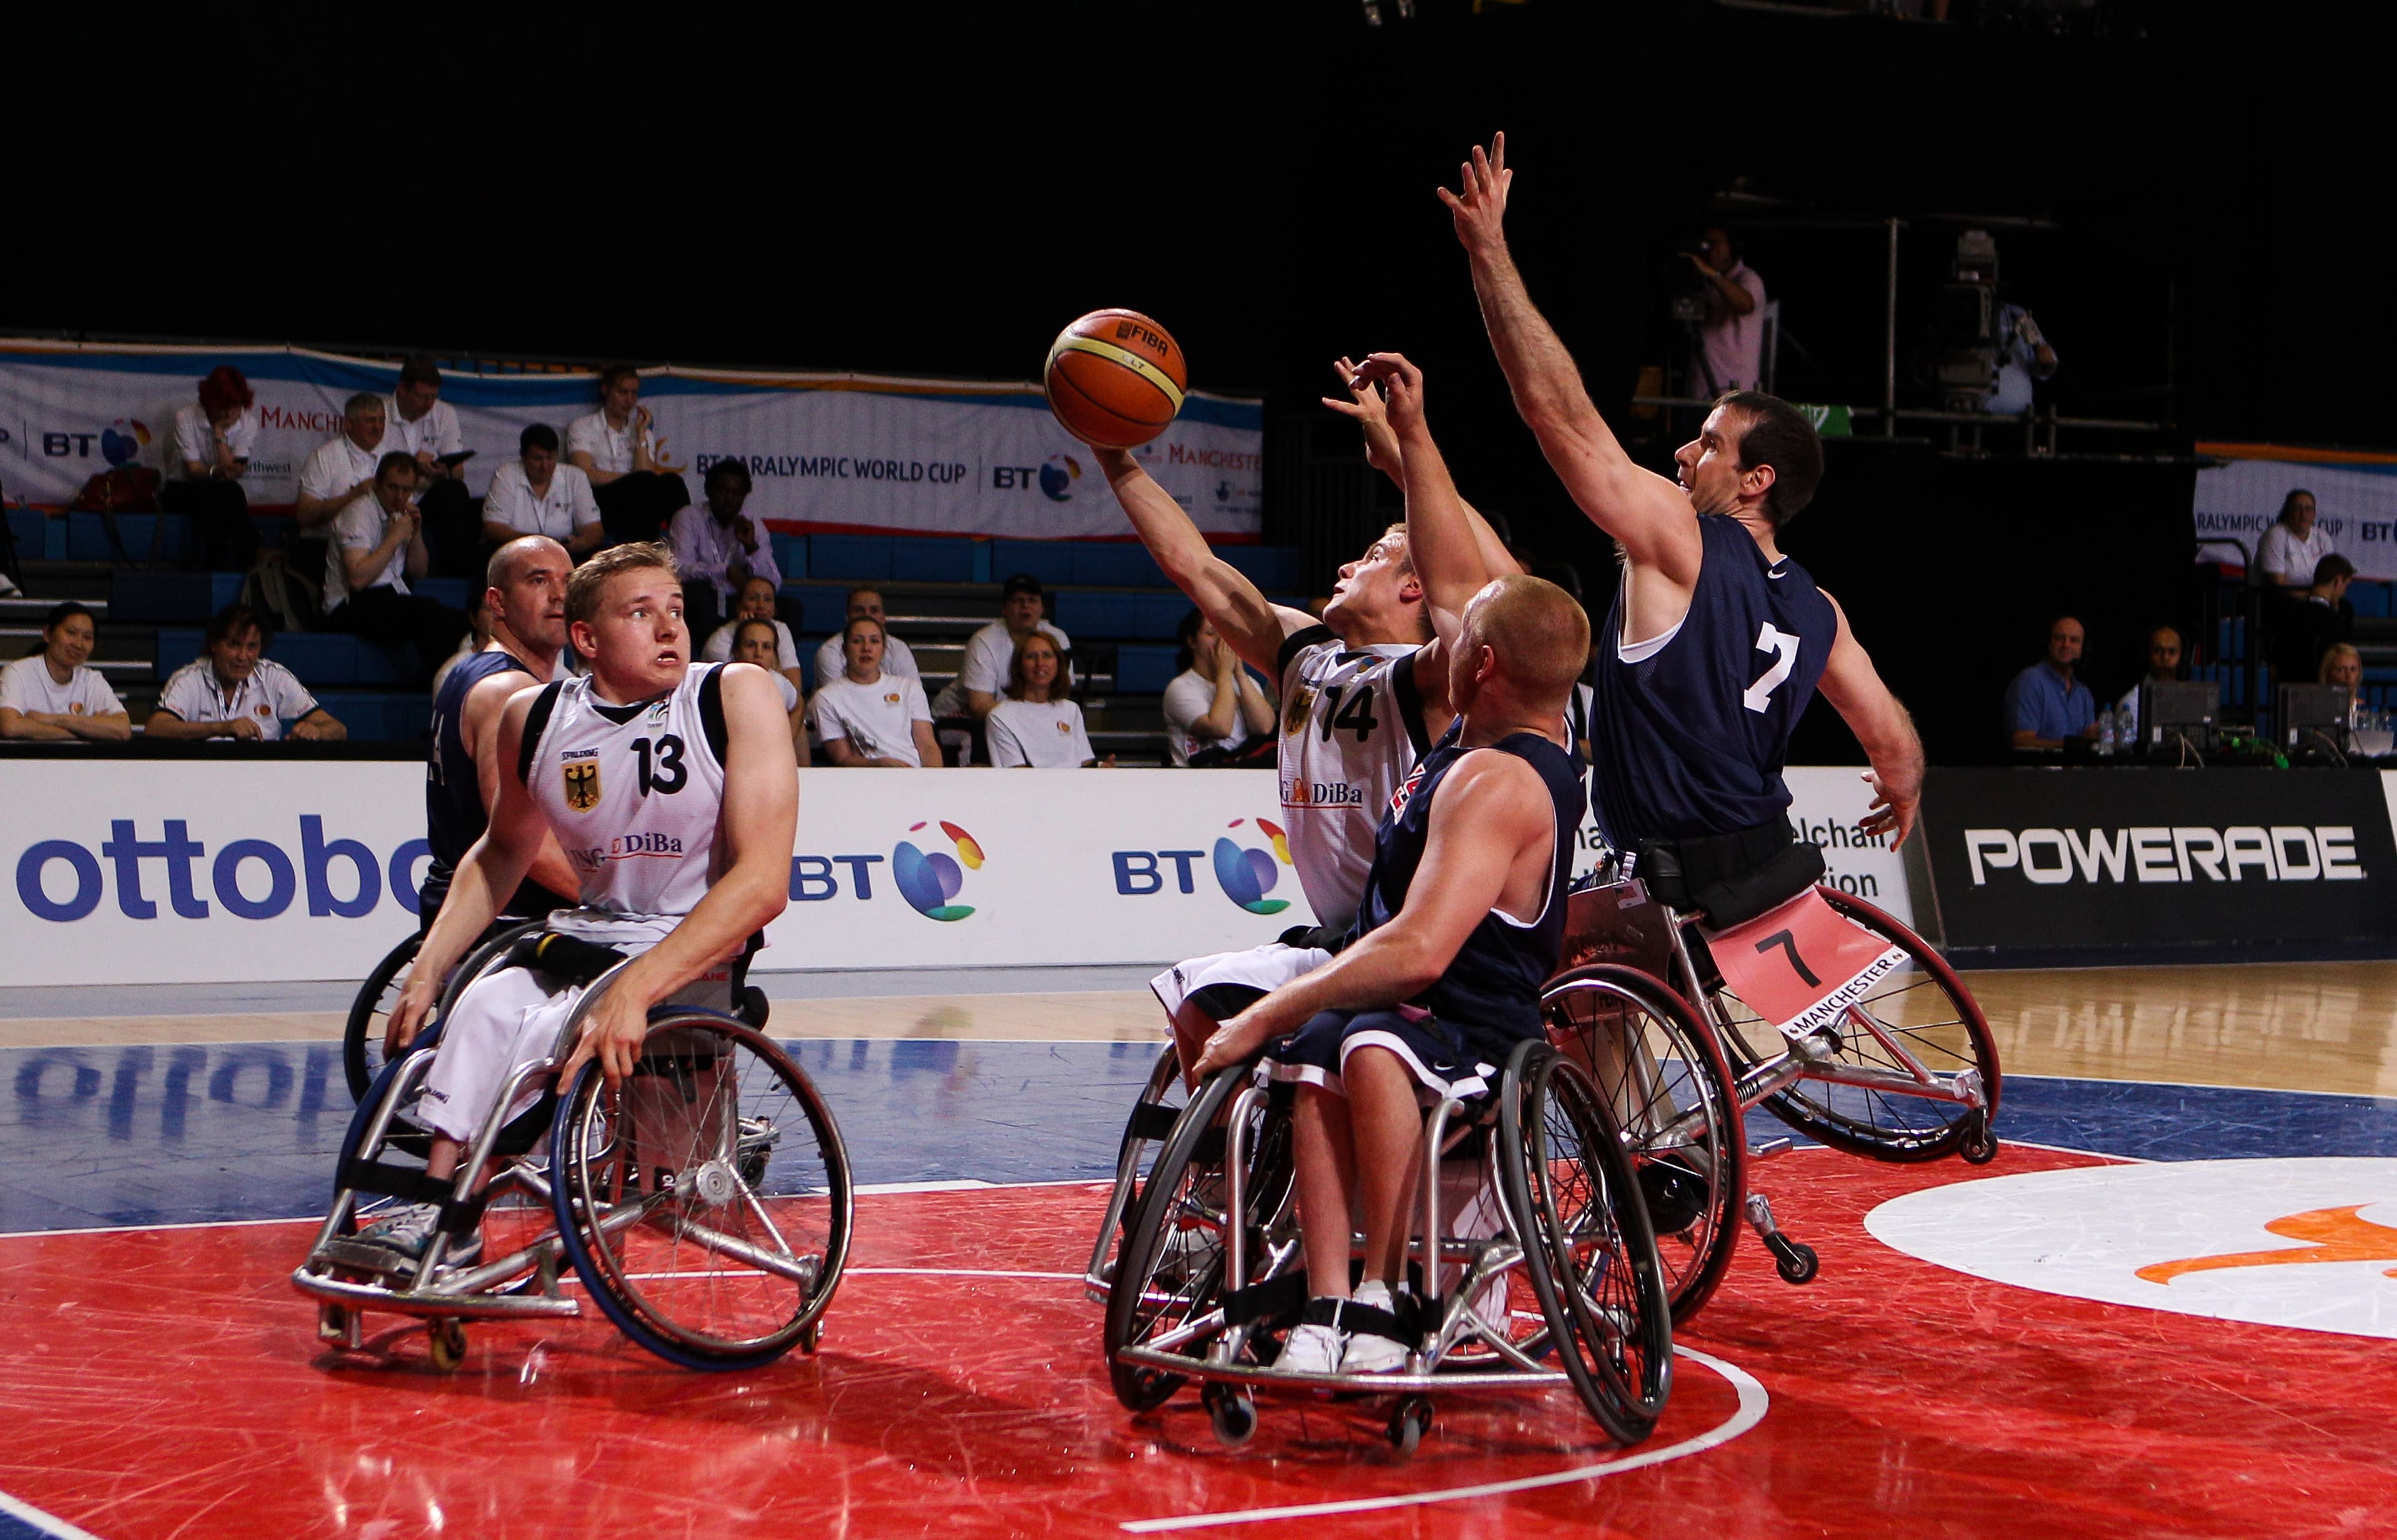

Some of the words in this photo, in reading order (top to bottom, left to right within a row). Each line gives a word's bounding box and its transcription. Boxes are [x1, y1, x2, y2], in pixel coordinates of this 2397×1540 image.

[1130, 325, 1168, 358] FIBA
[43, 431, 97, 458] BT
[853, 458, 923, 482] WORLD
[928, 463, 966, 483] CUP
[994, 466, 1037, 489] BT
[2361, 522, 2393, 541] BT
[1744, 620, 1800, 714] 7
[1322, 686, 1378, 742] 14
[630, 733, 688, 798] 13
[1313, 782, 1363, 804] DiBa
[625, 831, 683, 853] DiBa
[1964, 826, 2363, 886] POWERADE
[789, 855, 885, 901] BT
[1110, 850, 1205, 895] BT
[1755, 929, 1822, 988] 7
[1793, 958, 1894, 1031] MANCHESTER
